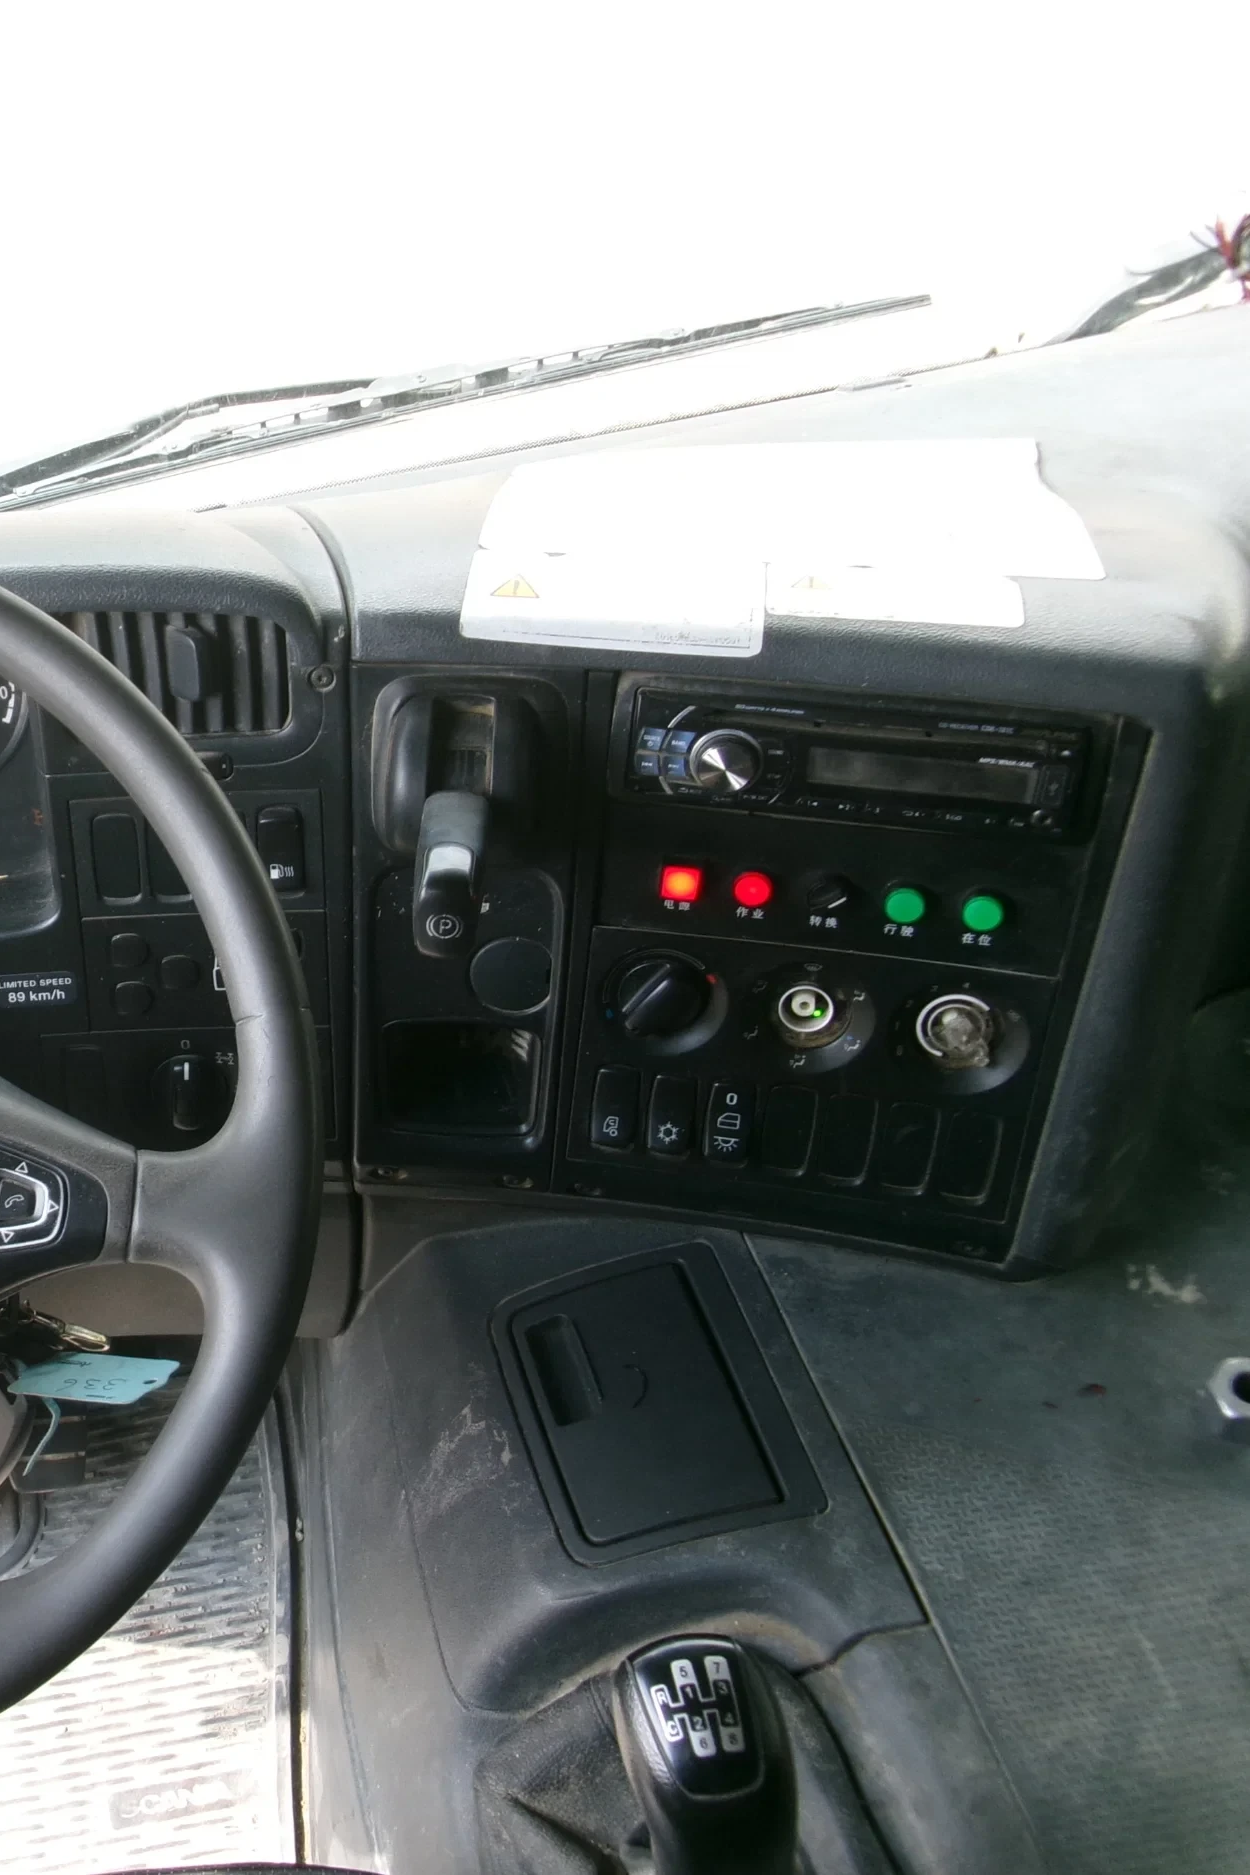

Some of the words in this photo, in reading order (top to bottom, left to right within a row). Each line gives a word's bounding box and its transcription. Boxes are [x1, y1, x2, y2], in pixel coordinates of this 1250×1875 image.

[663, 899, 691, 911] 电源
[735, 906, 764, 920] 作业
[809, 915, 838, 929] 转换
[883, 923, 915, 938] 行驶
[961, 932, 991, 946] 在位
[39, 977, 72, 987] SPEED
[8, 991, 26, 1003] 89
[29, 989, 66, 1002] km/h
[726, 1092, 738, 1106] 0
[55, 1378, 127, 1393] 336
[678, 1665, 688, 1678] 5
[713, 1661, 720, 1674] 7
[684, 1685, 694, 1699] 1
[717, 1681, 728, 1695] 3
[656, 1690, 667, 1705] R
[693, 1715, 705, 1730] 2
[699, 1737, 708, 1749] 6
